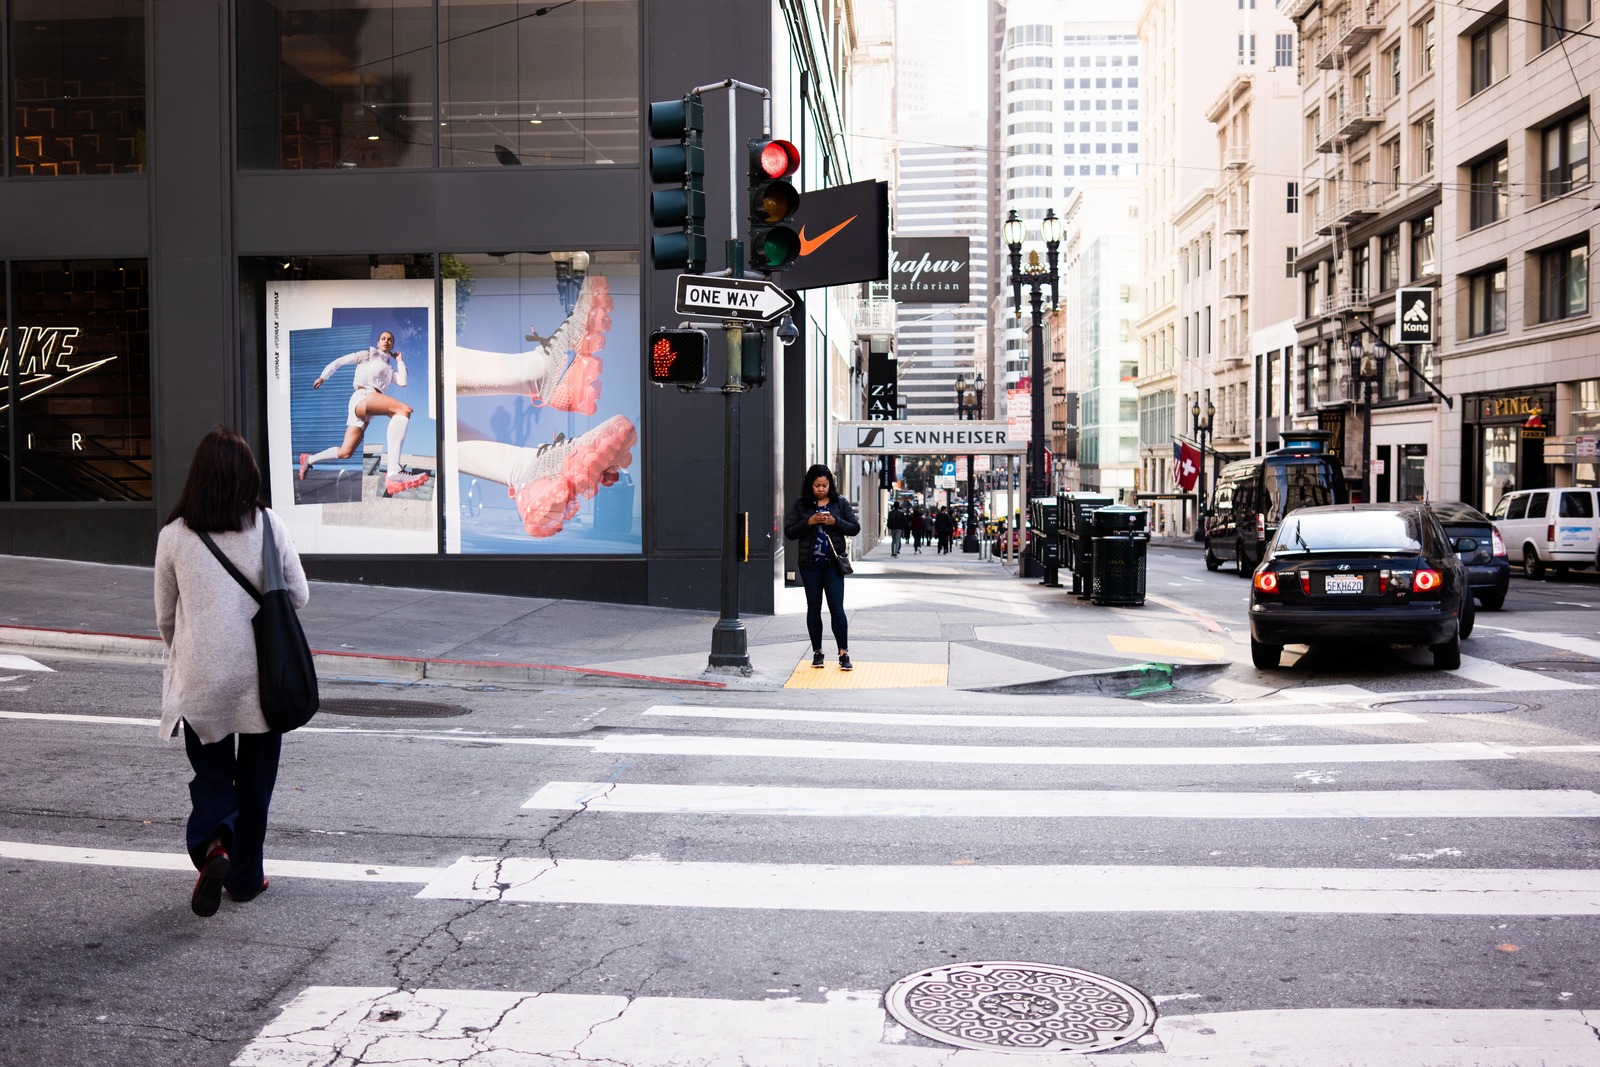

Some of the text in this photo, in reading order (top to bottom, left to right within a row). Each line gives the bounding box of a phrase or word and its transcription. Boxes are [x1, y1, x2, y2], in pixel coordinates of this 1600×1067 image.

[888, 250, 967, 282] hapur
[690, 288, 759, 307] ONE WAY
[1403, 323, 1429, 334] Kong
[1494, 396, 1533, 416] PINK
[893, 431, 1006, 444] SENNHEISER
